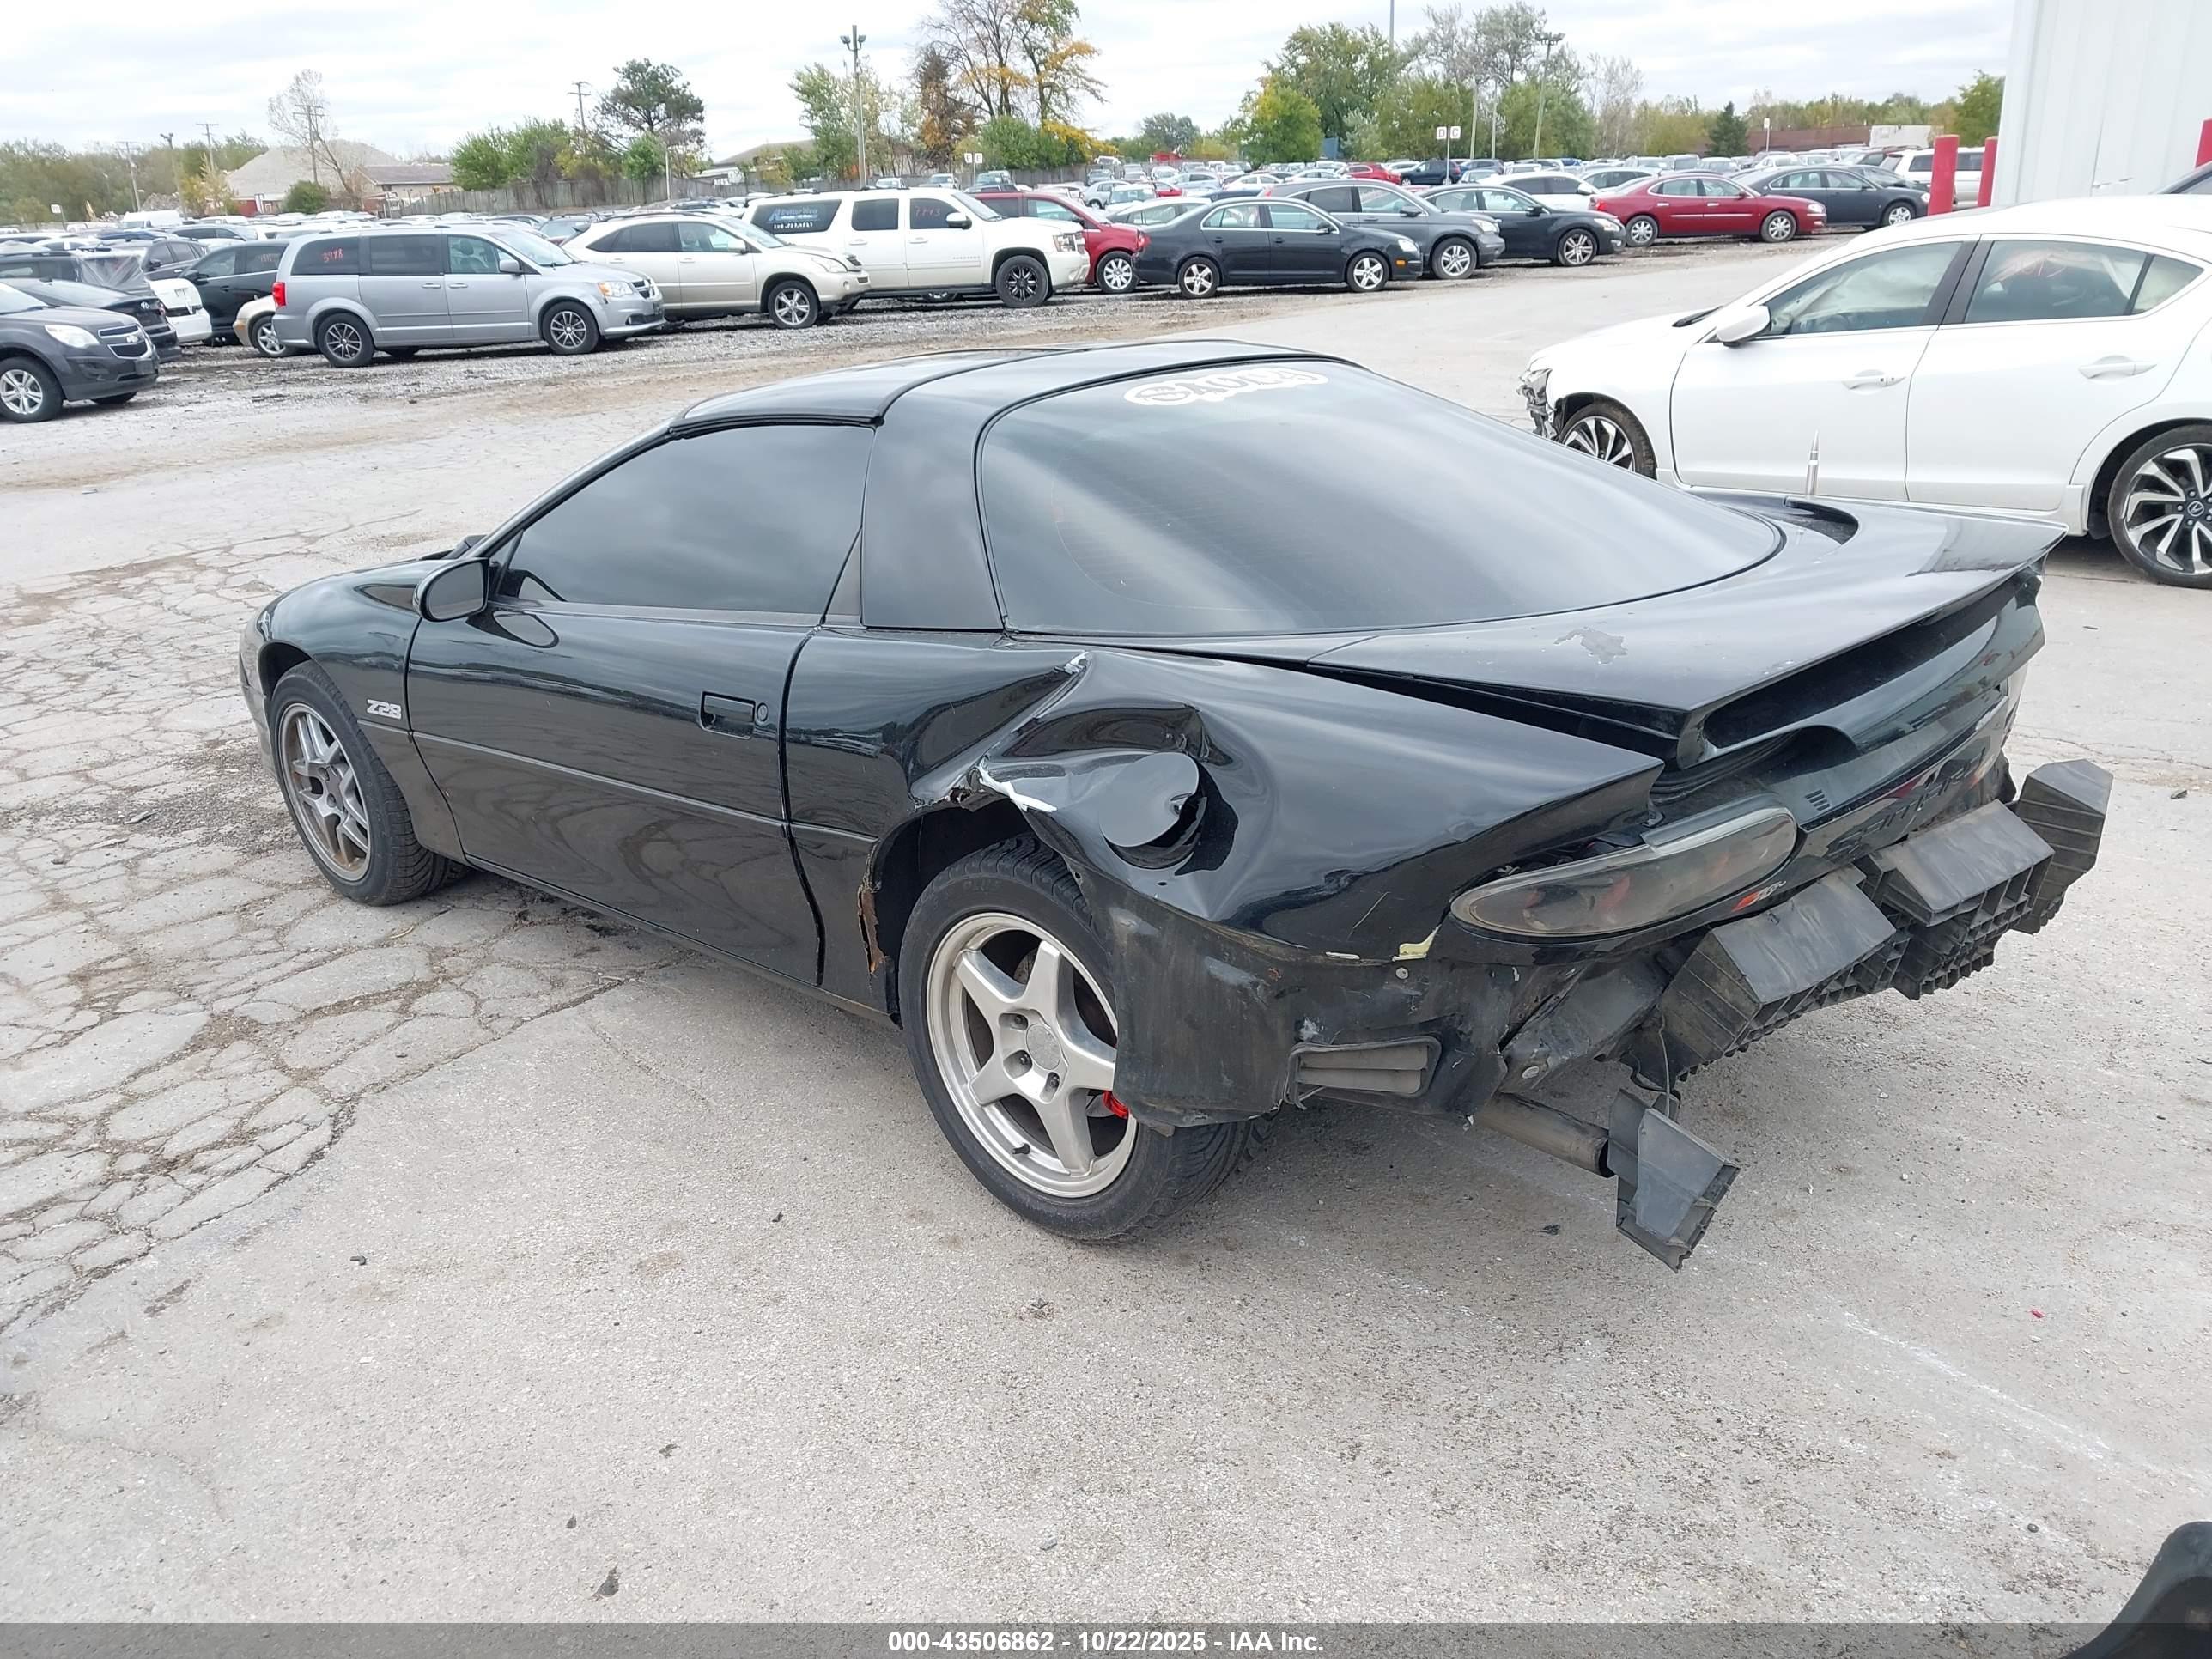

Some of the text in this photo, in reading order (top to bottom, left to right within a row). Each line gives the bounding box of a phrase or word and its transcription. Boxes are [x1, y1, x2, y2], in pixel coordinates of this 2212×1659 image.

[1438, 128, 1445, 137] D
[1452, 127, 1459, 137] C
[367, 699, 402, 720] Z28
